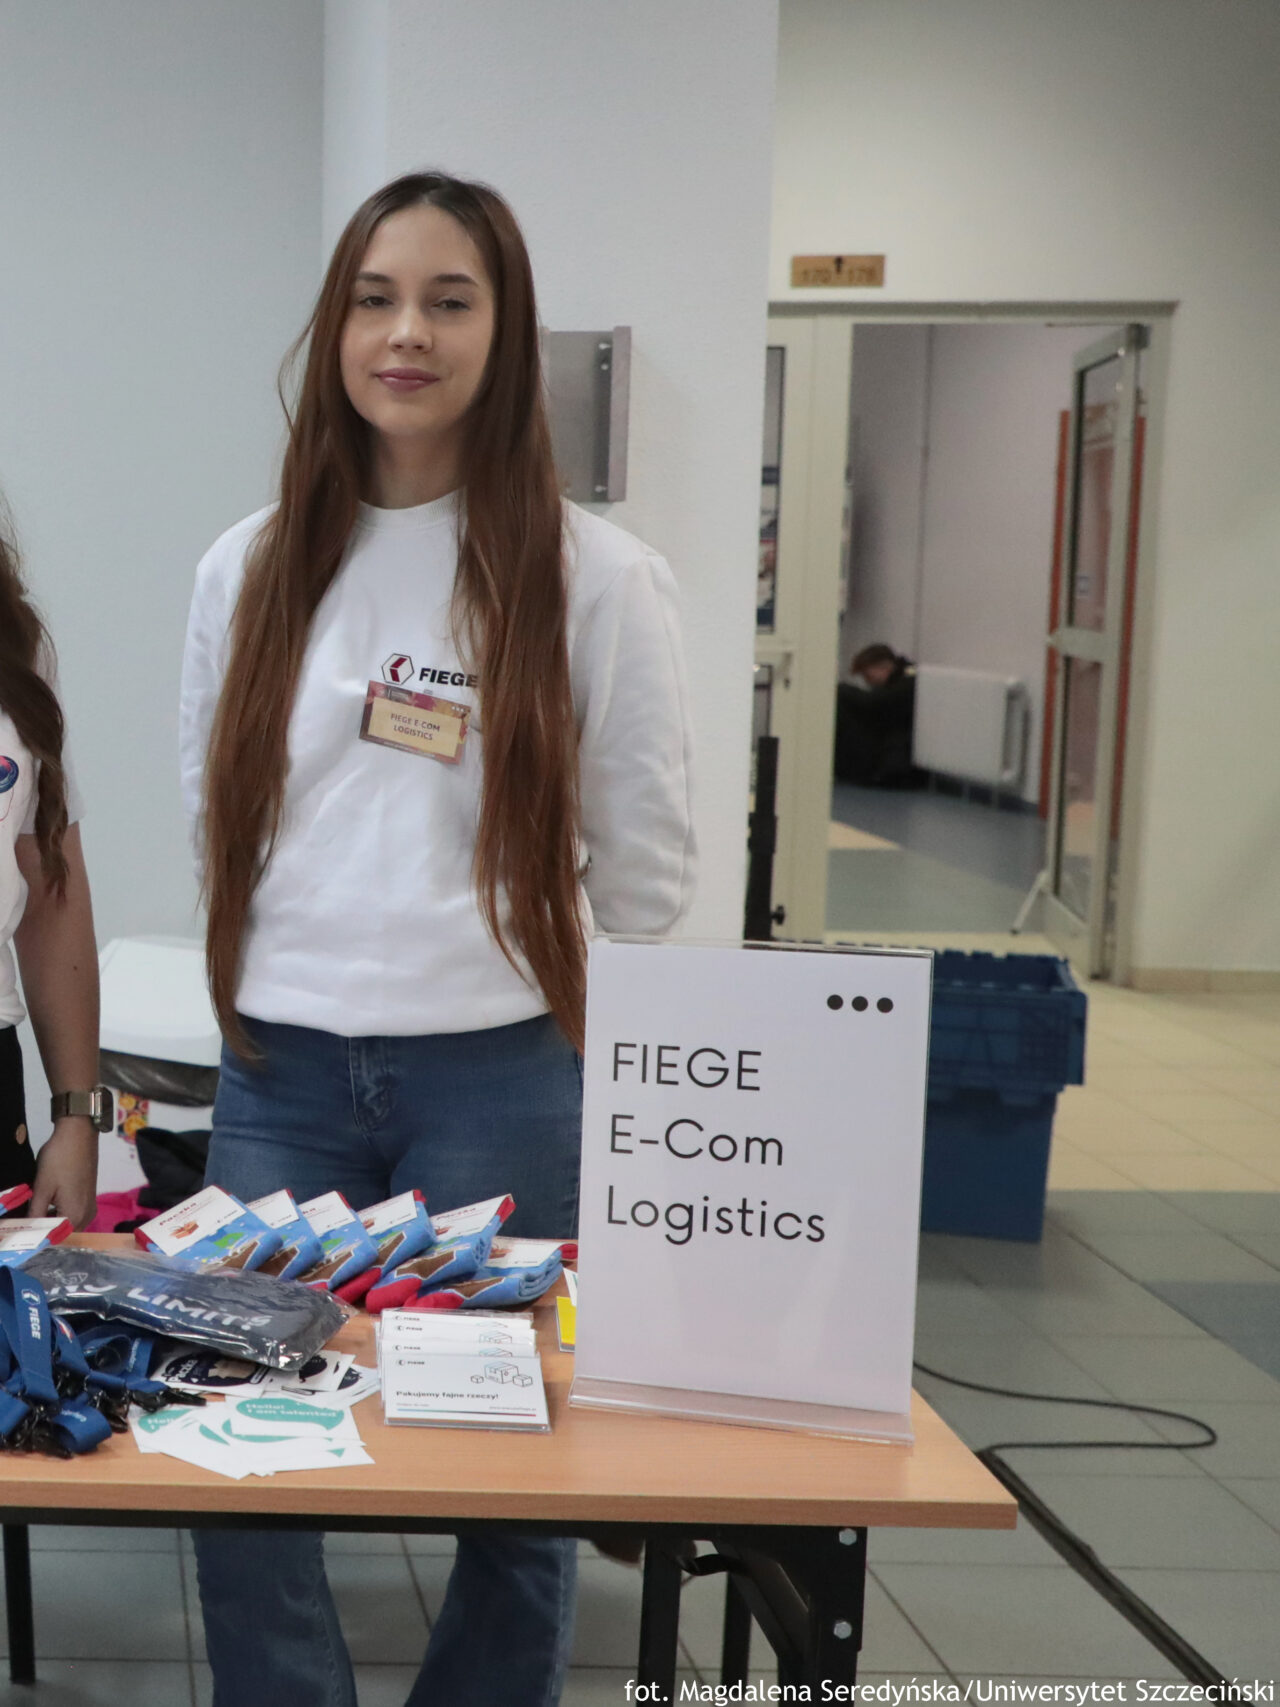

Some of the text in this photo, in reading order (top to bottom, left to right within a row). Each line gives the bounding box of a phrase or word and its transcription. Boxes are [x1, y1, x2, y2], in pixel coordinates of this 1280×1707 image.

[418, 667, 479, 689] FIEGE
[390, 713, 412, 725] FIEGE
[393, 725, 433, 740] LOGISTICS
[613, 1042, 762, 1091] FIEGE
[610, 1114, 783, 1166] E-Com
[607, 1185, 825, 1245] Logistics
[29, 1307, 41, 1340] FIEGE
